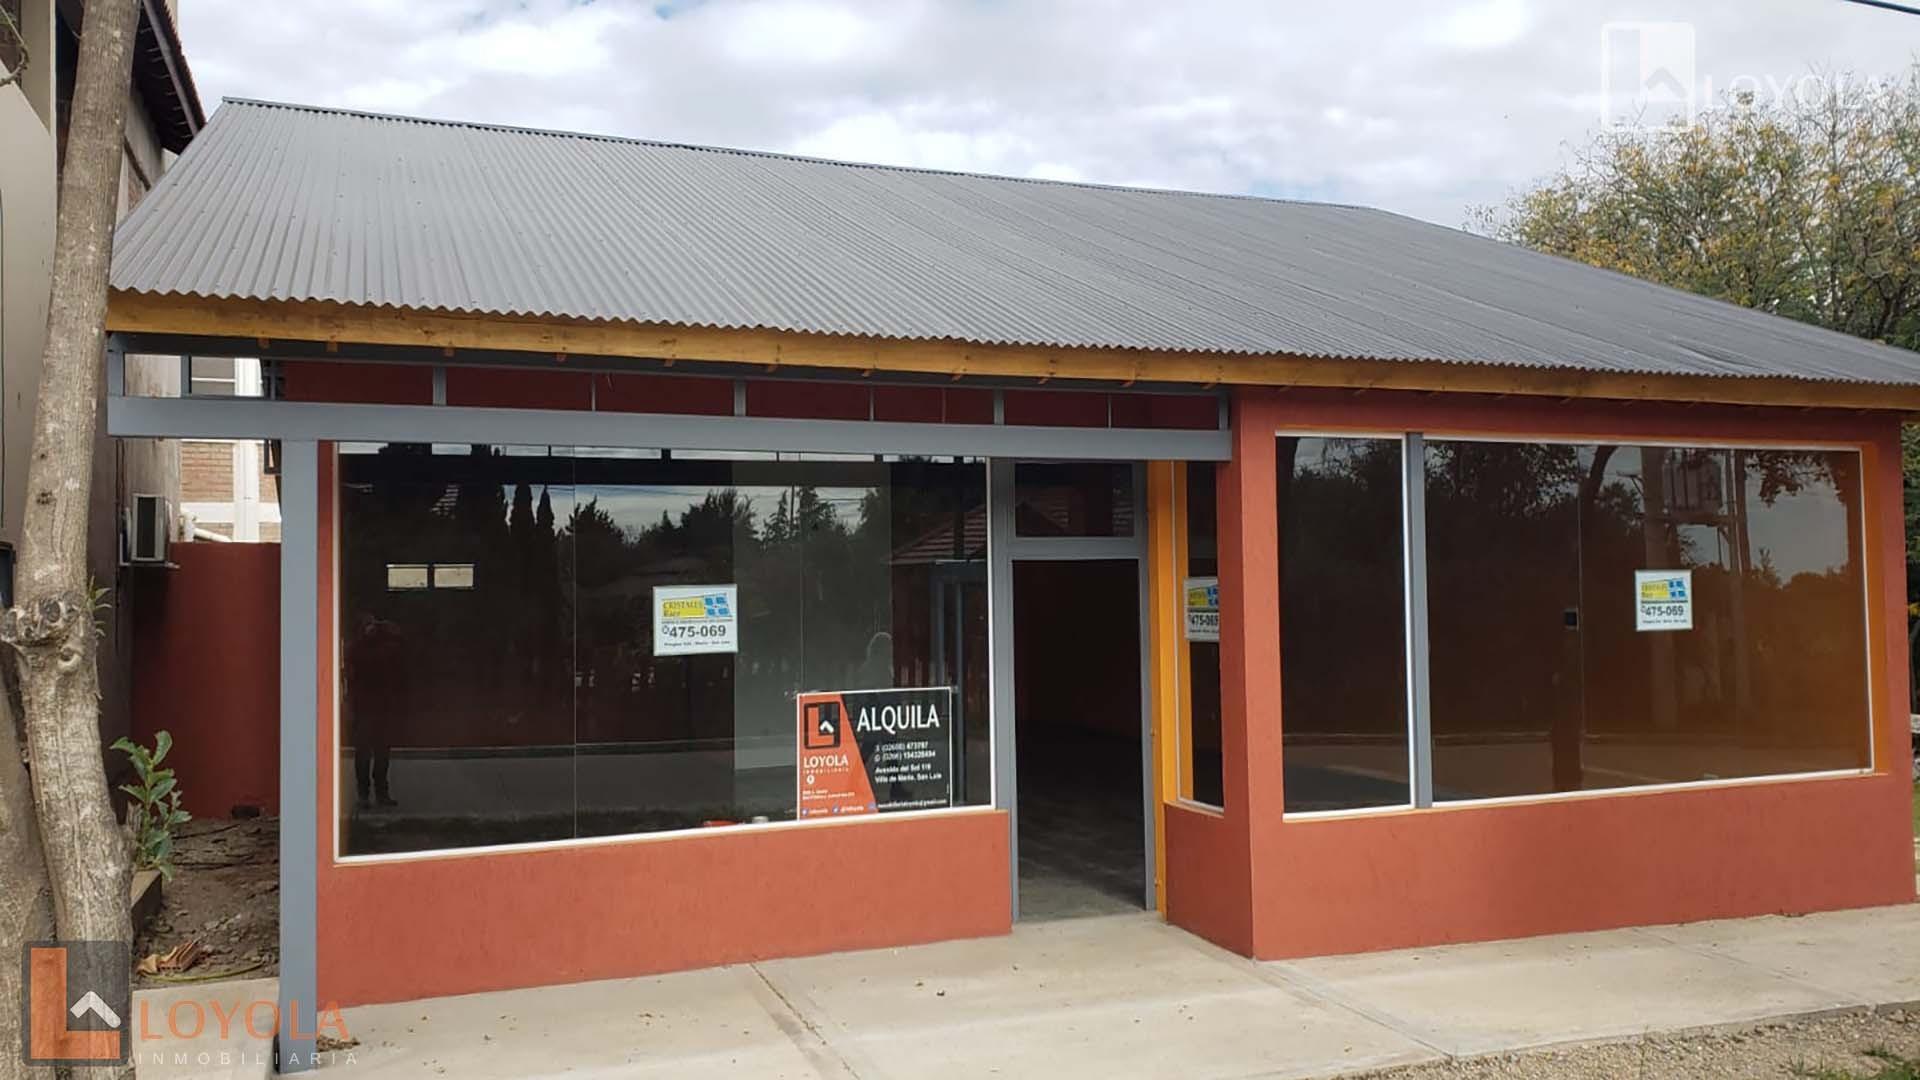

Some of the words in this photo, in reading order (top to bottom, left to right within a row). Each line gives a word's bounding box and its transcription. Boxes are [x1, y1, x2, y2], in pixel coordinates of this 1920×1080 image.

[1645, 605, 1684, 616] 475-069
[669, 624, 727, 638] 475-069
[856, 704, 940, 735] ALQUILA
[803, 755, 849, 769] LOYOLA
